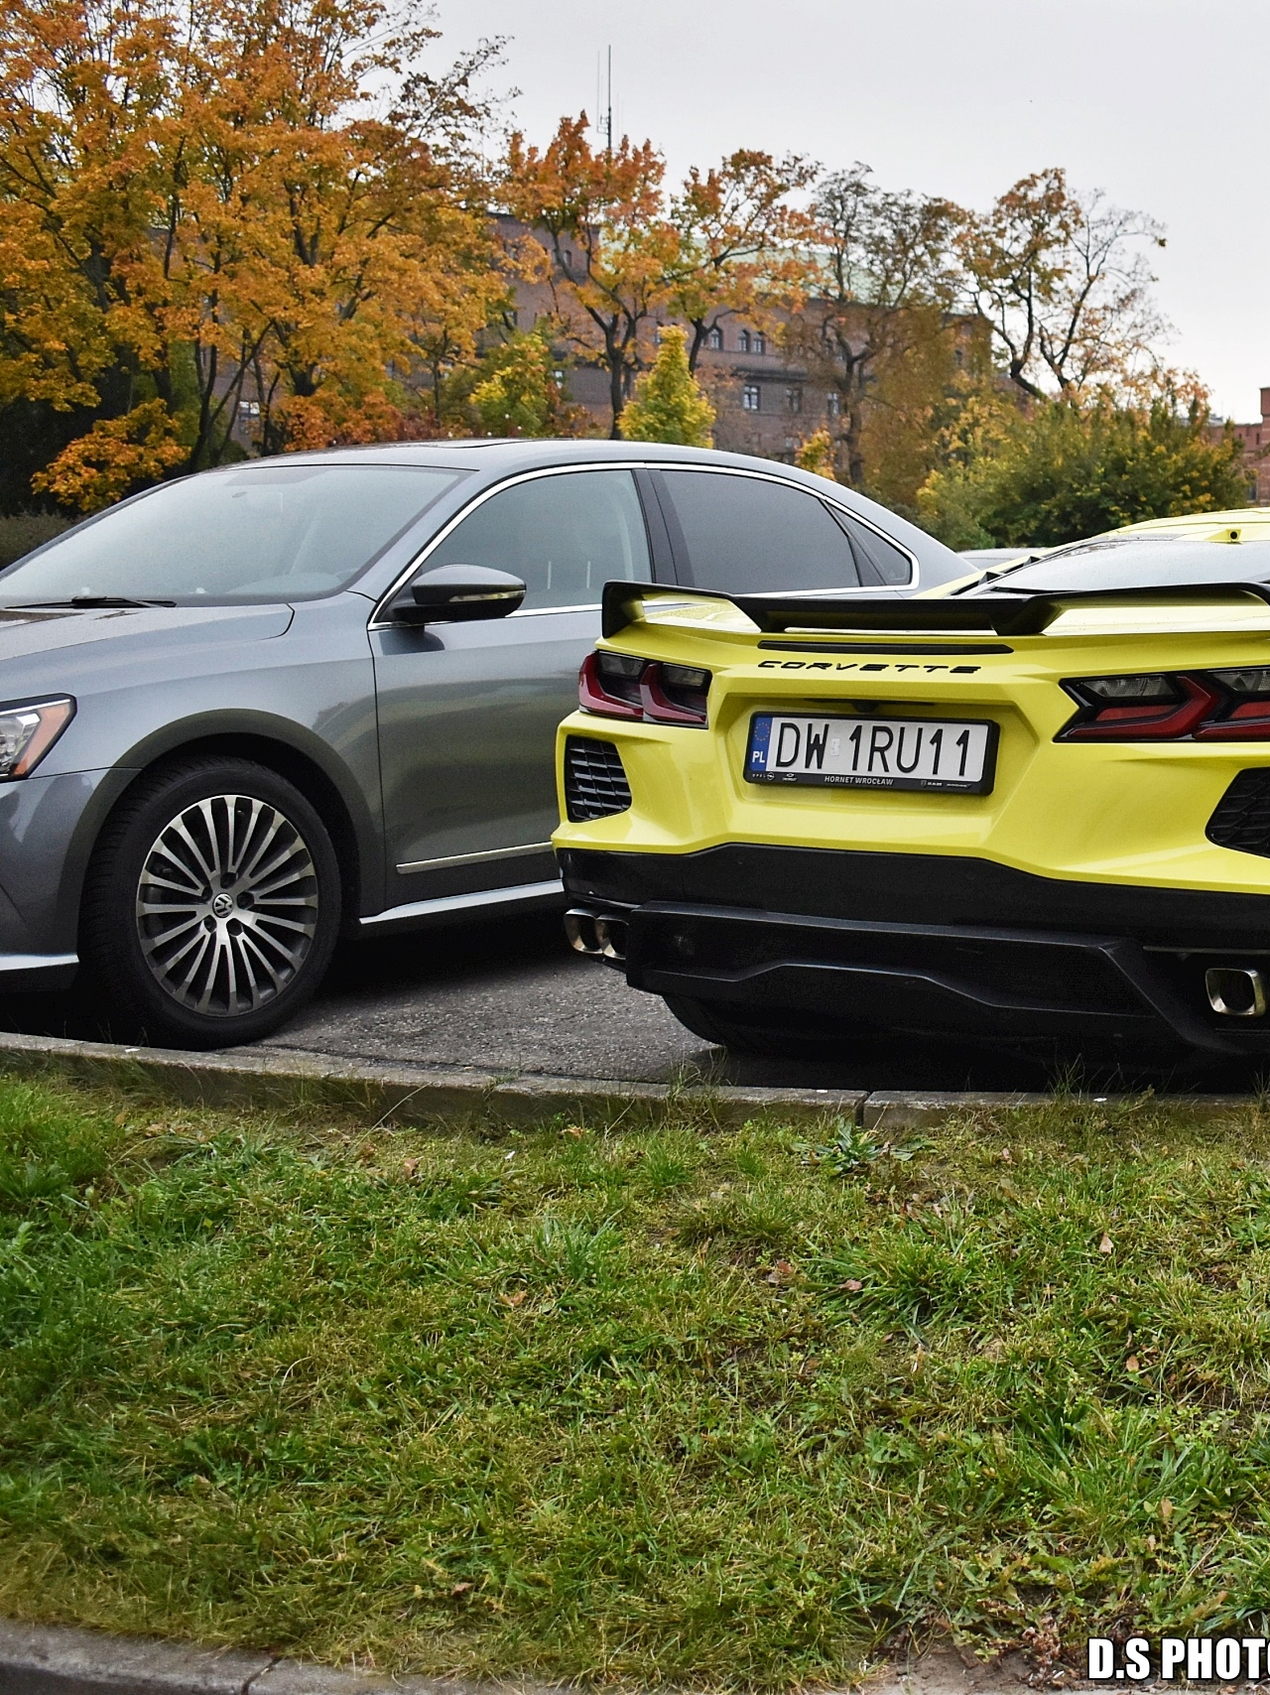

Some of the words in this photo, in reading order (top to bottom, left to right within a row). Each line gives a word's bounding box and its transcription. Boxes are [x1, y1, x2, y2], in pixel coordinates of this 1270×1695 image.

[758, 660, 982, 674] CORVETTE
[775, 722, 830, 770] DW
[848, 724, 970, 777] 1RU11
[752, 750, 766, 764] PL
[824, 775, 855, 784] HORNET
